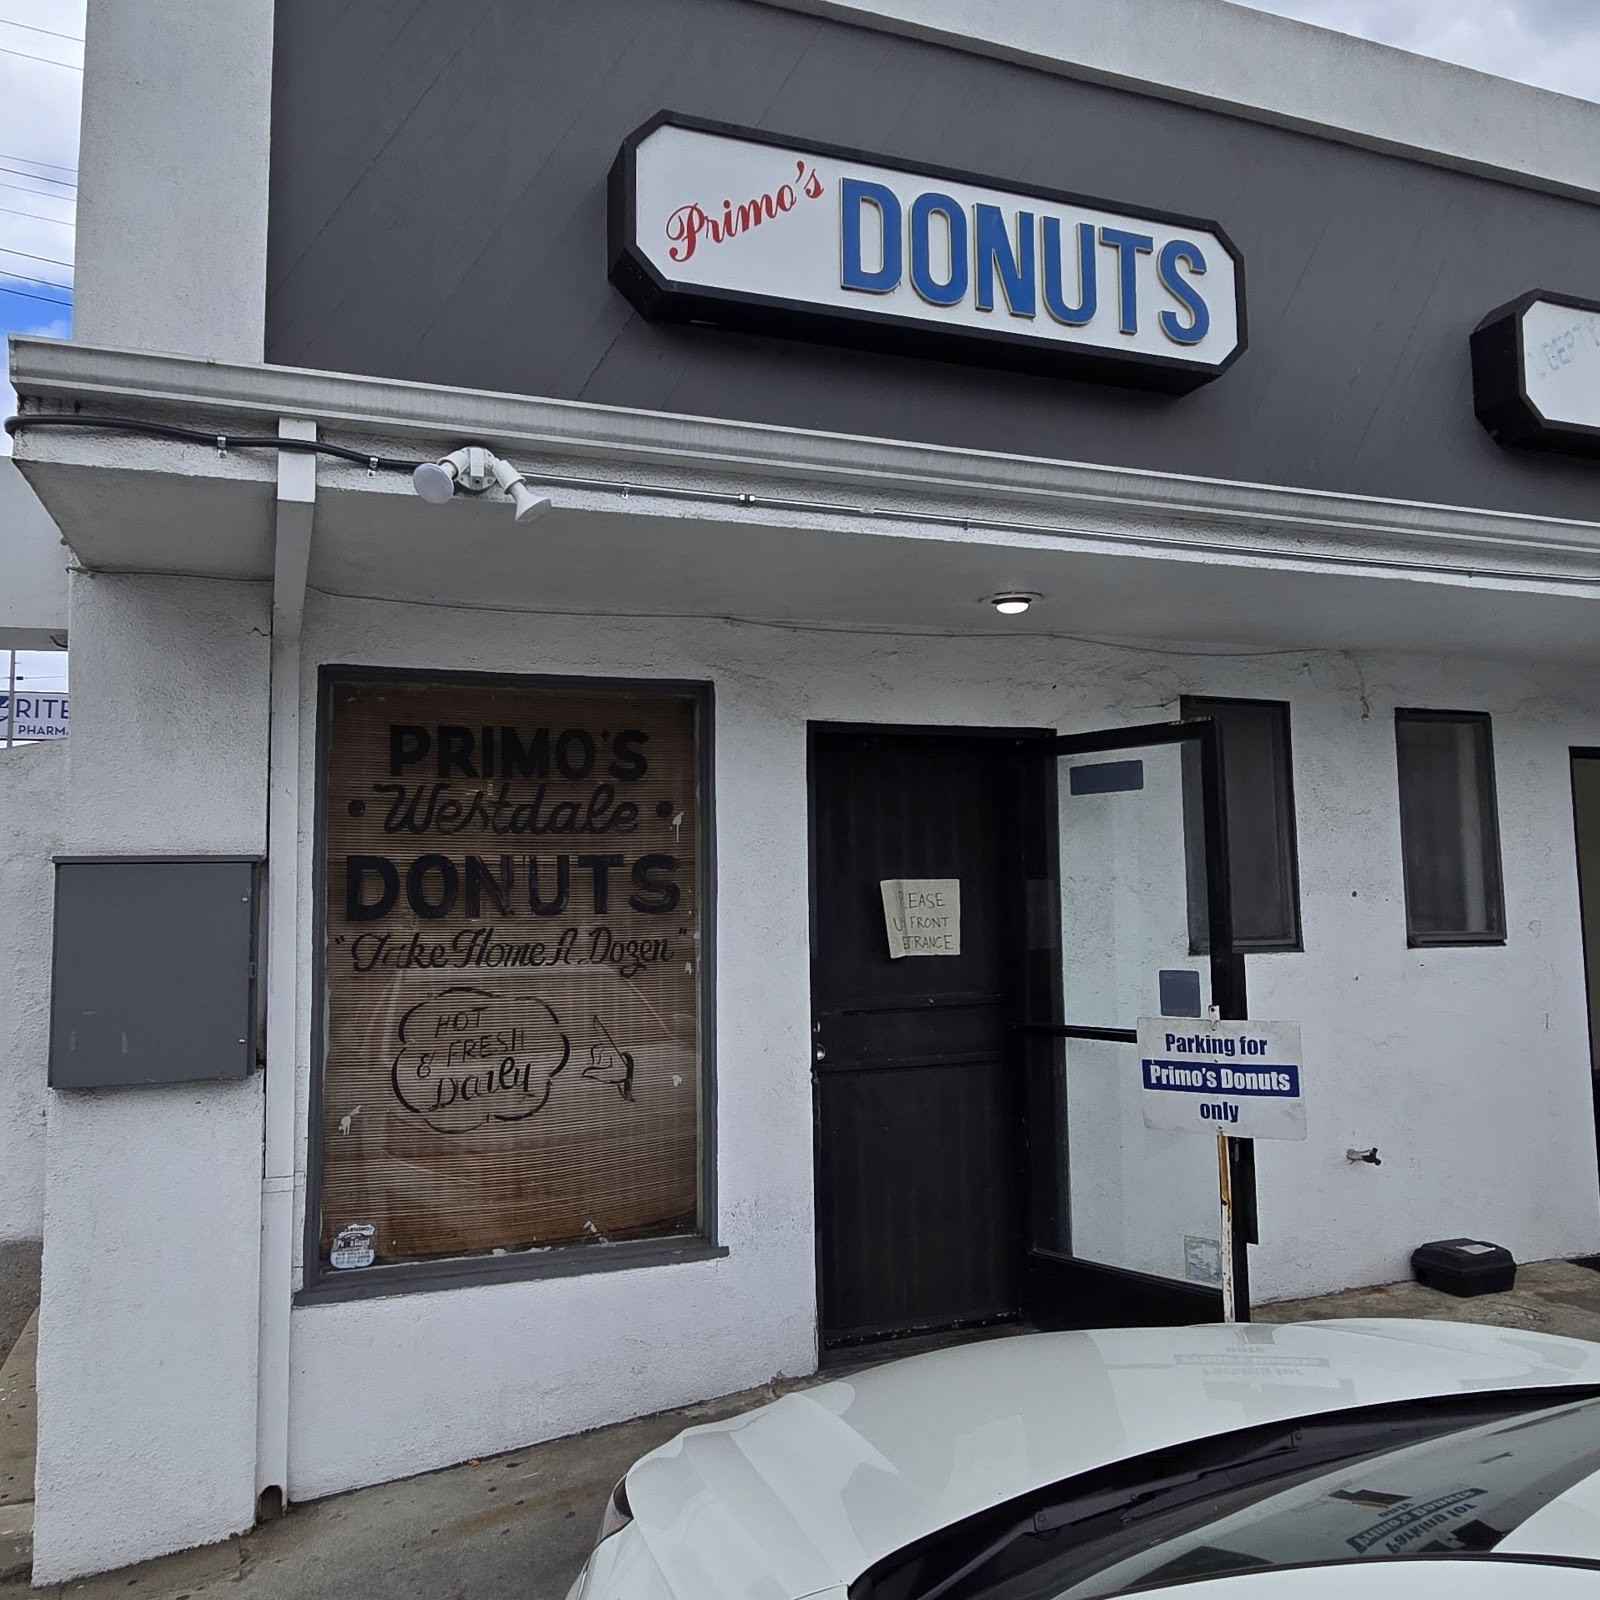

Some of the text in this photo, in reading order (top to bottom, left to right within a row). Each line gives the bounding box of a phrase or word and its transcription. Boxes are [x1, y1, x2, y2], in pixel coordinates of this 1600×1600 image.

[665, 160, 1211, 345] Primo's DONUTS
[18, 725, 68, 736] PHARM
[388, 725, 650, 781] PRIMO'S
[373, 783, 639, 835] Westdale
[346, 853, 681, 921] DONUTS
[910, 916, 950, 929] FRONT
[451, 928, 546, 968] Home
[435, 1006, 489, 1038] HOT
[447, 1028, 524, 1067] FRESH
[1165, 1033, 1268, 1056] Parking for
[1150, 1064, 1291, 1091] Primo's Donuts
[1200, 1102, 1239, 1122] only
